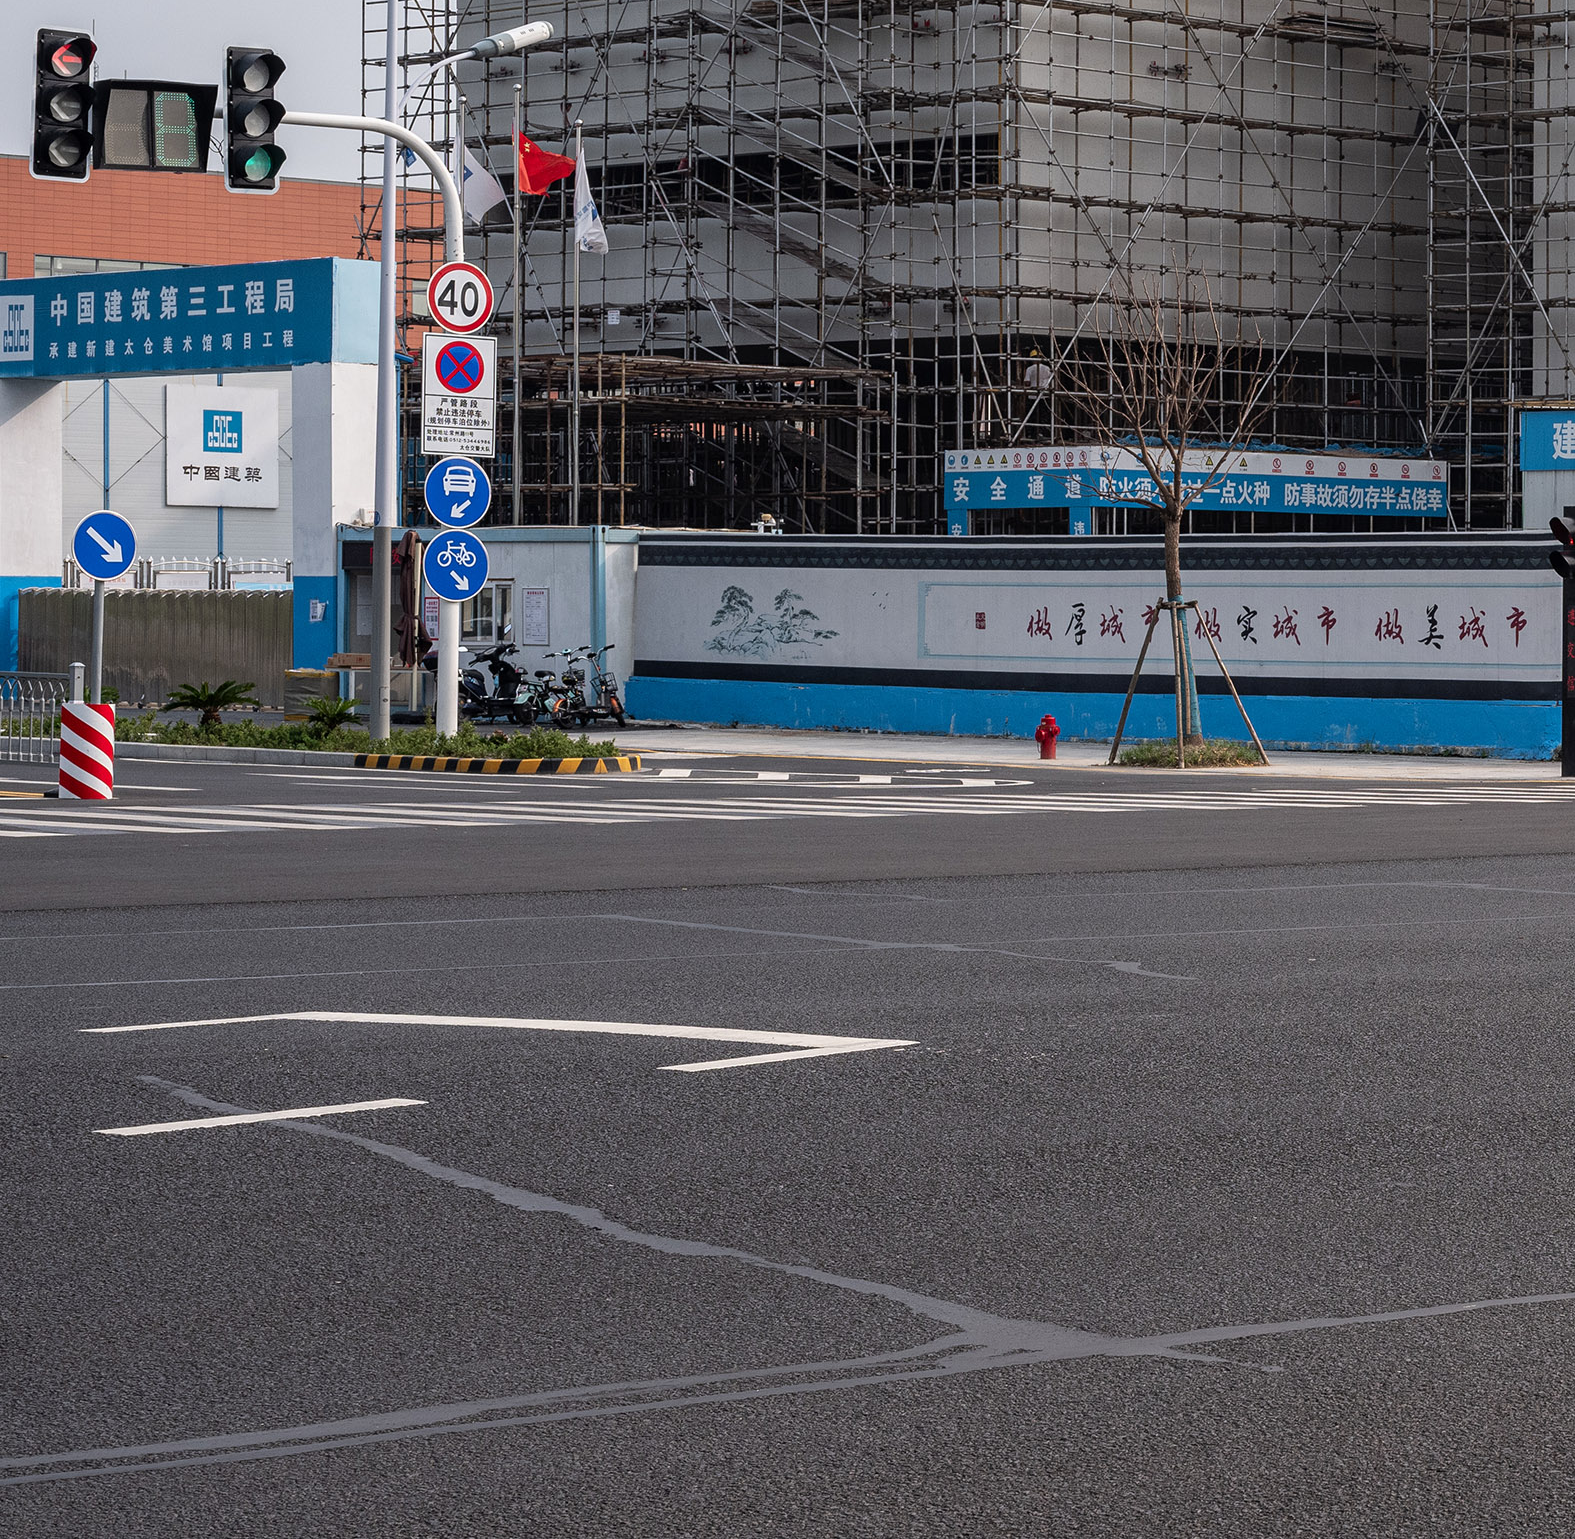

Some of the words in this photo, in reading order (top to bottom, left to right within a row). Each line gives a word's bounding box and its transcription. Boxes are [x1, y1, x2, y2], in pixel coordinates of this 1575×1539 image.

[50, 278, 294, 327] 中国建筑第三工程局
[437, 280, 478, 317] 40
[49, 329, 294, 359] 承建新建太仓美术馆项目工程
[436, 408, 482, 419] 禁止违法停车
[440, 398, 478, 409] 严管路段
[953, 475, 1082, 502] 安全通道
[1284, 482, 1443, 511] 防事故须勿存半点侥幸
[1374, 603, 1528, 650] 做美城市
